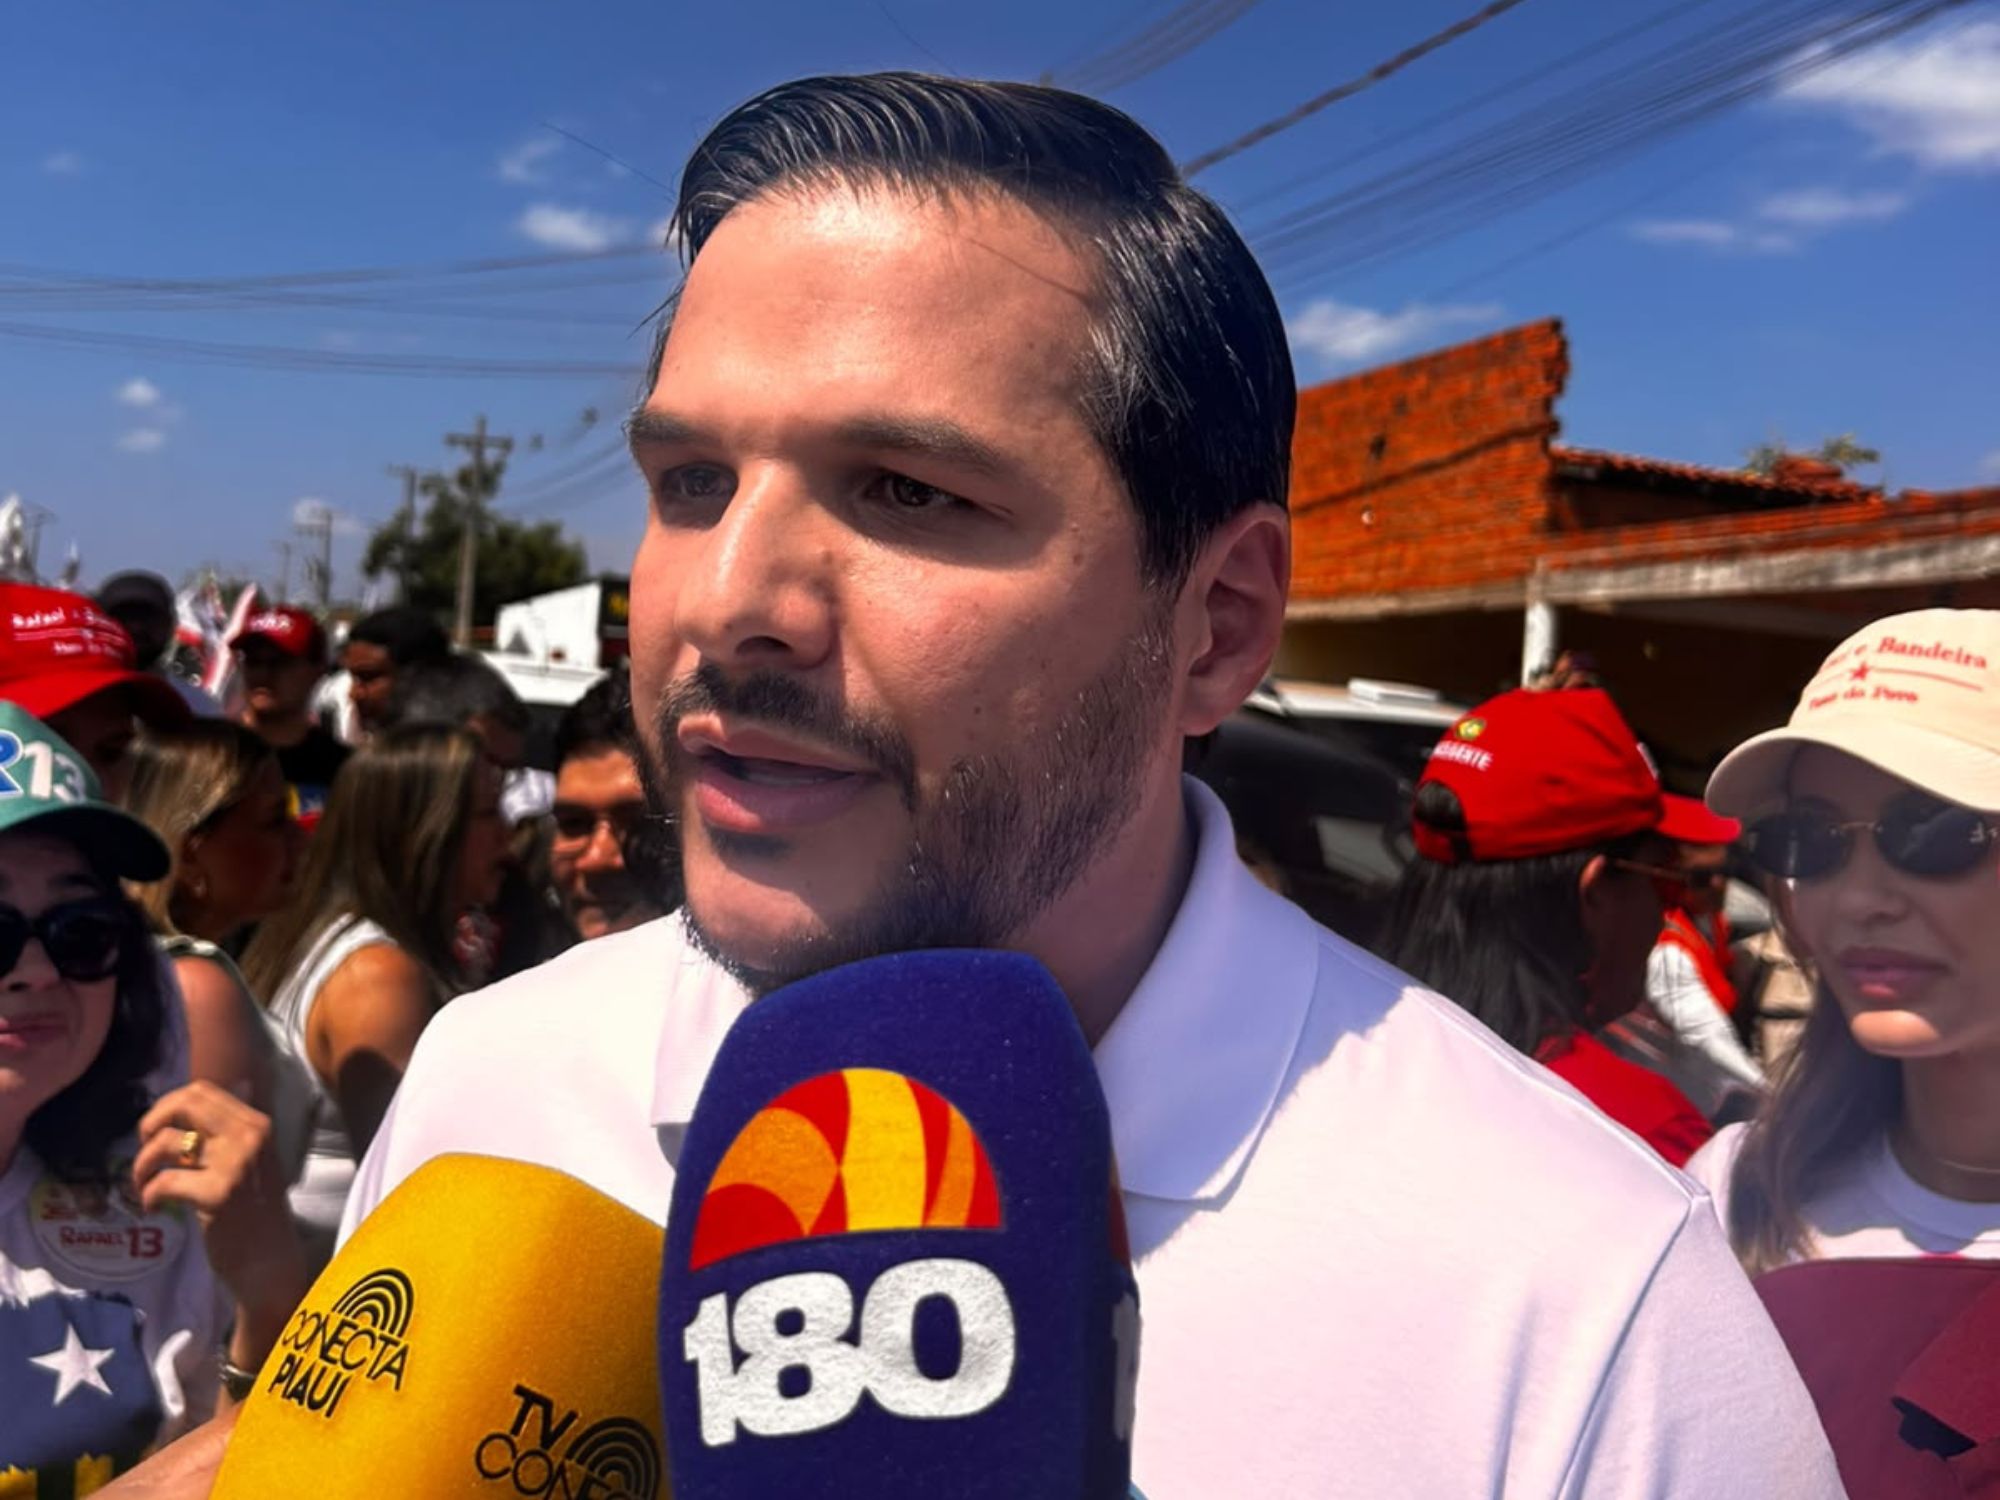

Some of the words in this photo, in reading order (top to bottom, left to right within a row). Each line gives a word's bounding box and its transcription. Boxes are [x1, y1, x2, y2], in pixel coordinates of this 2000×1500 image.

[1877, 636, 1987, 669] Bandeira
[127, 1225, 165, 1259] 13
[281, 1307, 410, 1392] CONECTA
[684, 1257, 1016, 1446] 180
[511, 1383, 580, 1450] TV
